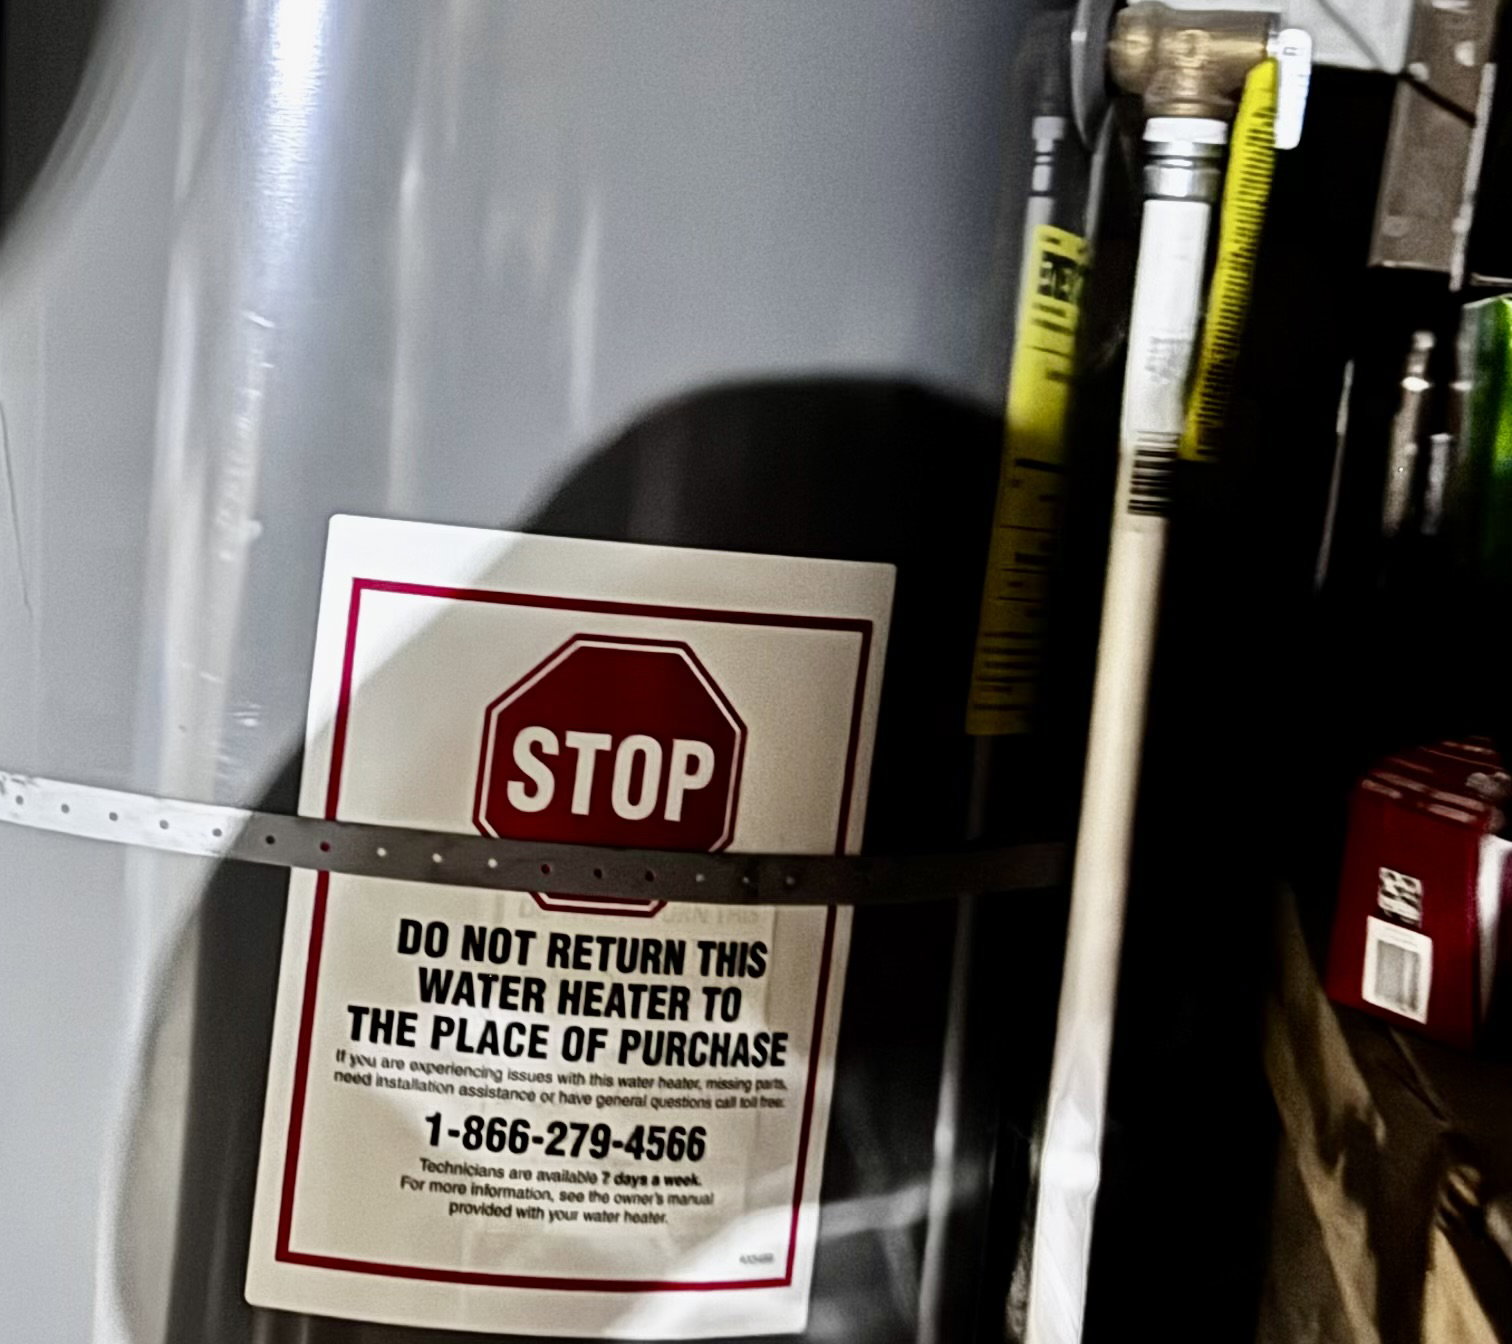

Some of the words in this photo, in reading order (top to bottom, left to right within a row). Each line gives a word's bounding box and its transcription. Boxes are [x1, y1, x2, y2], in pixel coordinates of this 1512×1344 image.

[506, 725, 716, 823] STOP
[397, 919, 450, 958] DO
[460, 925, 537, 965] NOT
[546, 933, 687, 975] RETURN
[697, 941, 768, 978] THIS
[418, 968, 547, 1012] WATER
[557, 980, 691, 1020] HEATER
[702, 986, 742, 1023] TO
[347, 1006, 419, 1047] THE
[430, 1016, 550, 1059] PLACE
[561, 1026, 609, 1063] OF
[617, 1030, 789, 1067] PURCHASE
[333, 1071, 373, 1087] need
[375, 1074, 455, 1094] installation
[458, 1085, 537, 1103] assistance
[539, 1091, 556, 1104] or
[558, 1090, 593, 1106] have
[595, 1094, 648, 1108] general
[650, 1096, 712, 1110] questions
[335, 1048, 347, 1063] If
[349, 1053, 377, 1068] you
[380, 1057, 406, 1071] are
[409, 1061, 503, 1083] experiencing
[507, 1069, 553, 1084] issues
[557, 1072, 586, 1086] with
[589, 1073, 614, 1088] this
[617, 1076, 655, 1089] water
[706, 1079, 753, 1094] missing
[424, 1111, 707, 1162] 1-866-279-4566
[399, 1174, 426, 1191] For
[428, 1181, 468, 1196] more
[559, 1190, 585, 1203] see
[588, 1190, 611, 1205] the
[667, 1193, 715, 1206] manual
[419, 1157, 505, 1179] Technicians
[508, 1168, 533, 1181] are
[536, 1169, 599, 1185] available
[601, 1170, 611, 1185] 7
[613, 1172, 648, 1188] days
[650, 1174, 661, 1187] a
[448, 1202, 513, 1218] provided
[515, 1206, 545, 1220] with
[548, 1209, 579, 1223] your
[583, 1210, 620, 1223] water
